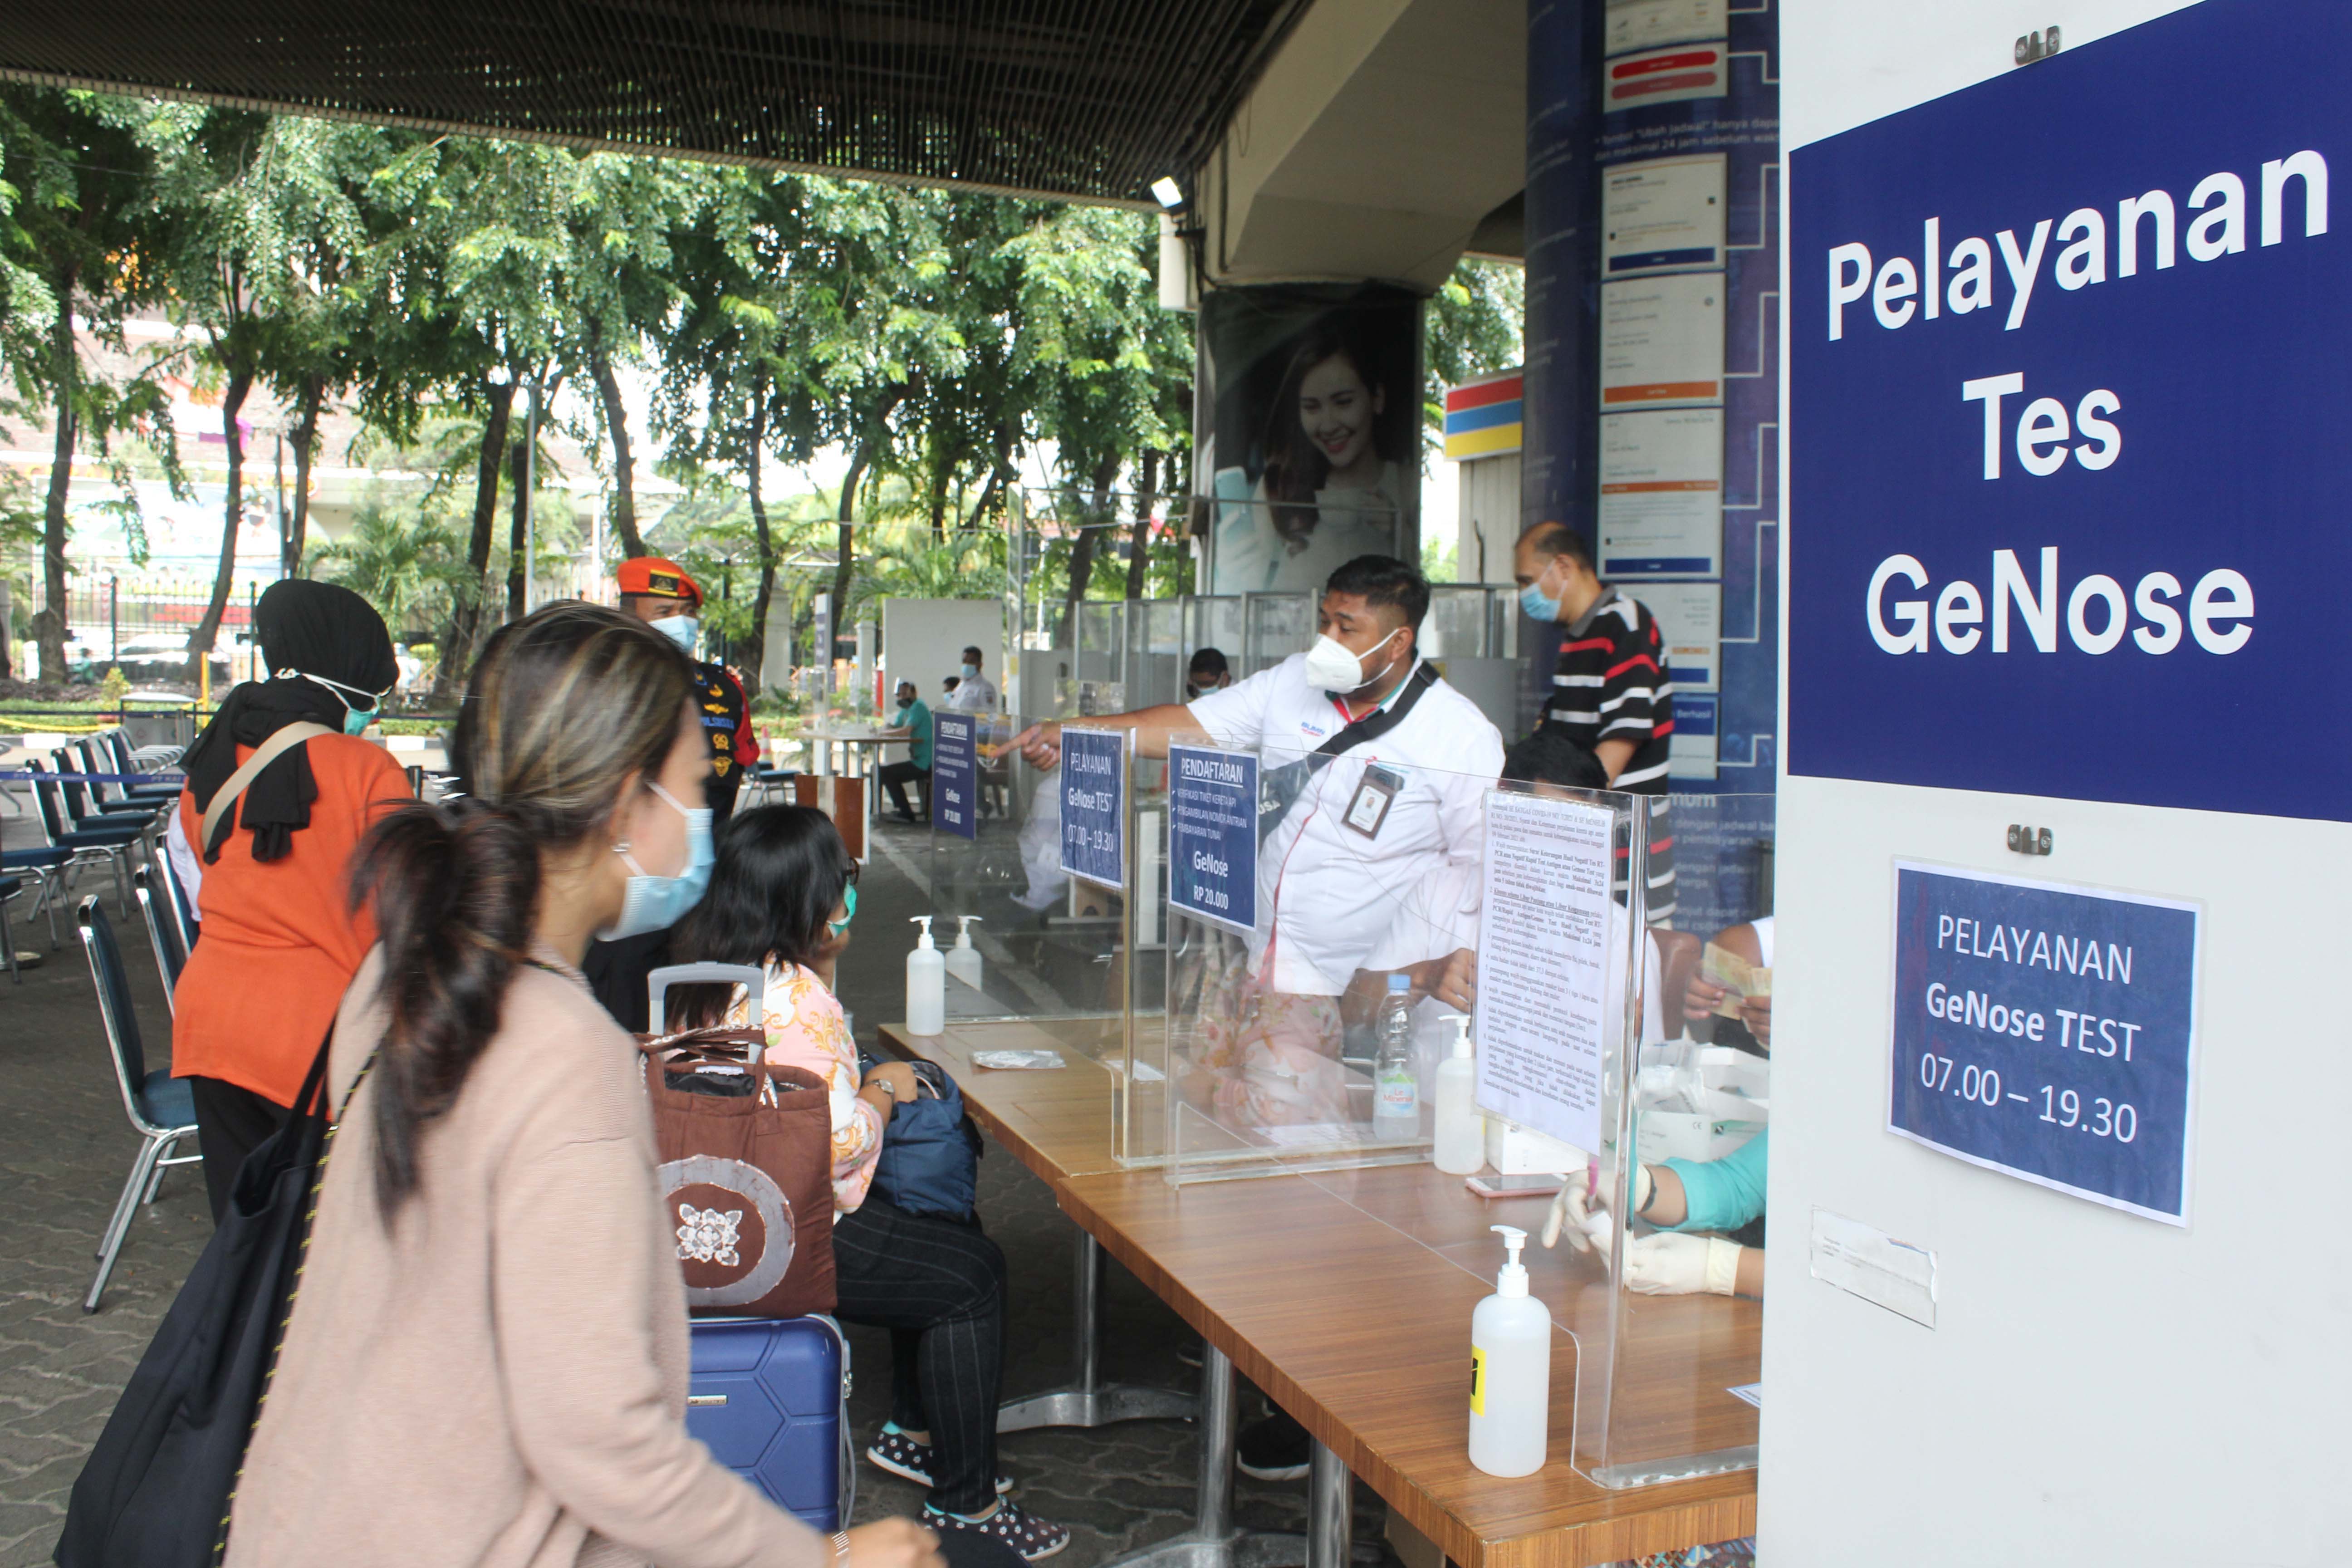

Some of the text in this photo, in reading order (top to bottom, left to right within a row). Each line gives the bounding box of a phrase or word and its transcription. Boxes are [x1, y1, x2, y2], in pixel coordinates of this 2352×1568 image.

[1829, 150, 2328, 341] Pelayanan
[1963, 372, 2122, 480] Tes
[1867, 546, 2254, 655] GeNose
[1071, 752, 1111, 775] PELAYANAN
[1181, 758, 1243, 783] PENDAFTARAN
[1068, 787, 1113, 813] GeNose TEST
[1068, 824, 1086, 846] 07.00
[1093, 830, 1113, 852] 19.30
[1759, 821, 1774, 831] ba
[1194, 851, 1228, 877] GeNose
[1194, 885, 1228, 910] RP 20.000
[1938, 915, 2132, 985] PELAYANAN
[1927, 982, 2142, 1062] GeNose TEST
[1921, 1053, 2000, 1106] 07.00
[2039, 1085, 2137, 1143] 19.30
